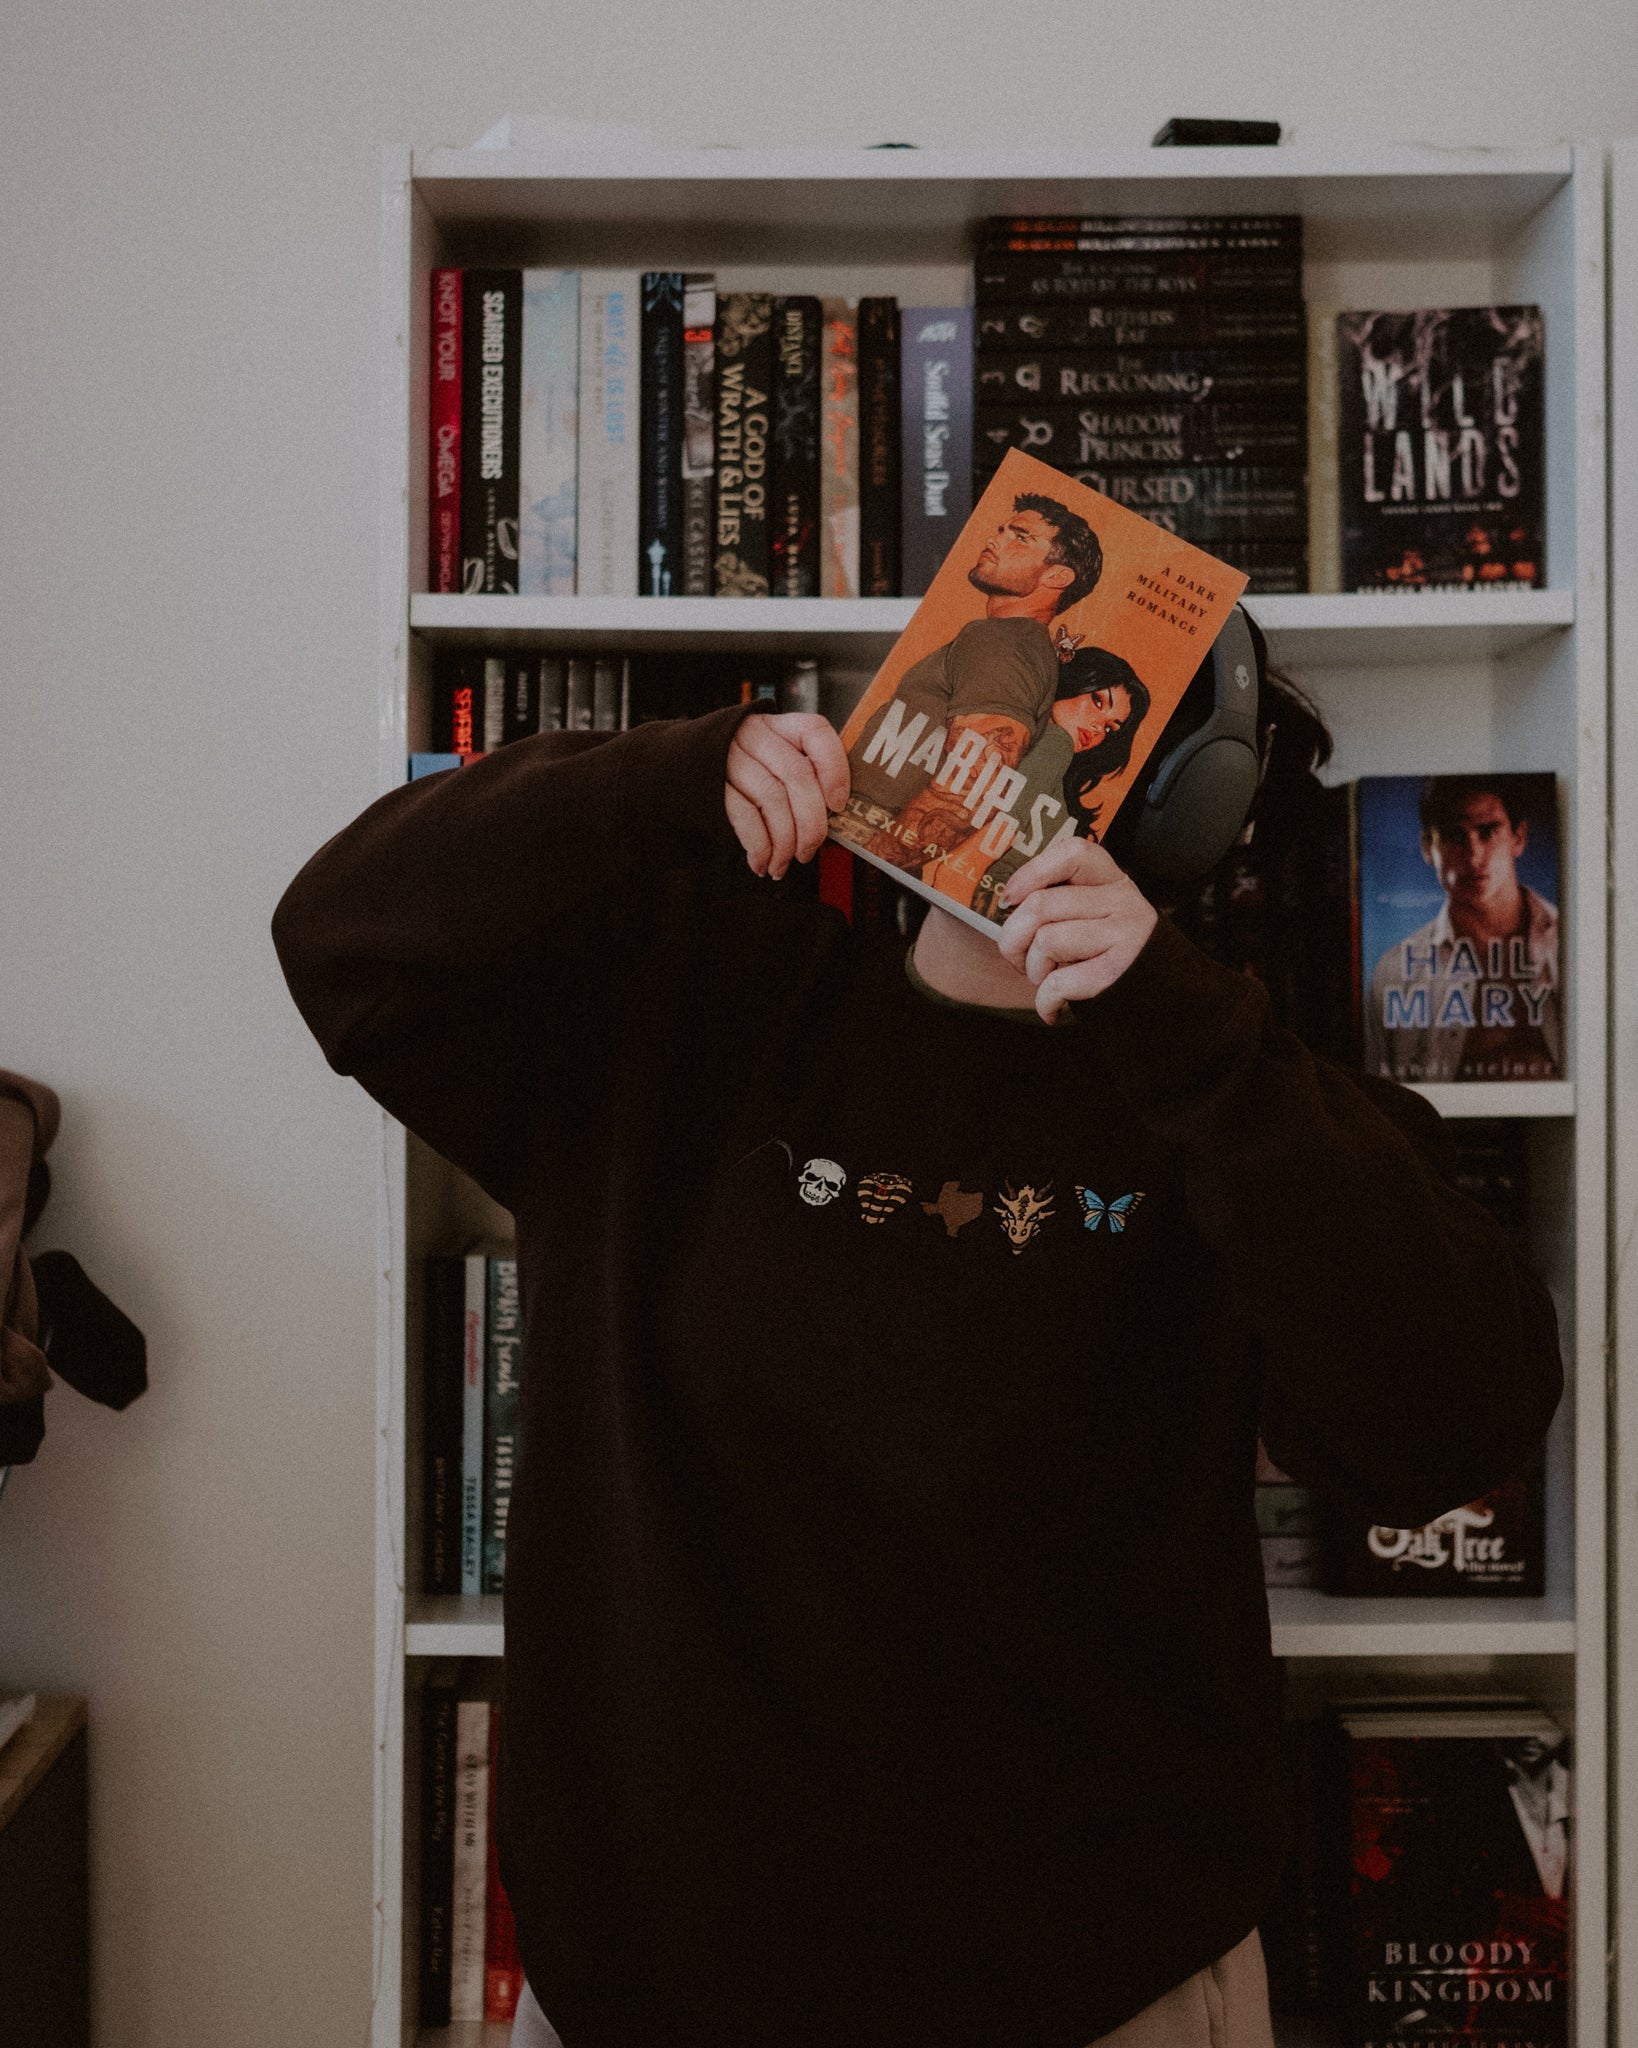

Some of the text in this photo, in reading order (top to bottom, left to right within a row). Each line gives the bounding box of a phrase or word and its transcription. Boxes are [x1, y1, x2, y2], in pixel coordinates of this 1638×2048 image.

[437, 270, 457, 500] KNOT YOUR OMEGA
[480, 289, 505, 480] SCARRED EXECUTIONERS
[1059, 367, 1201, 396] RECKONING
[1077, 409, 1185, 436] SHADOW
[717, 362, 745, 547] WRATH & LIES
[743, 385, 769, 522] A GOD OF
[1078, 433, 1185, 464] PRINCESS
[1363, 426, 1521, 502] LANDS
[689, 518, 706, 589] CASTLE
[1136, 573, 1207, 617] MILITARY
[1161, 567, 1216, 602] A DARK
[1126, 590, 1197, 636] ROMANCE
[851, 799, 1006, 897] LEXIE AXELSO
[1404, 935, 1538, 981] HAIL
[1382, 983, 1551, 1030] MARY
[1430, 1507, 1507, 1573] Tree
[1384, 1940, 1538, 1966] BLOODY
[1366, 1979, 1553, 2003] KINGDOM
